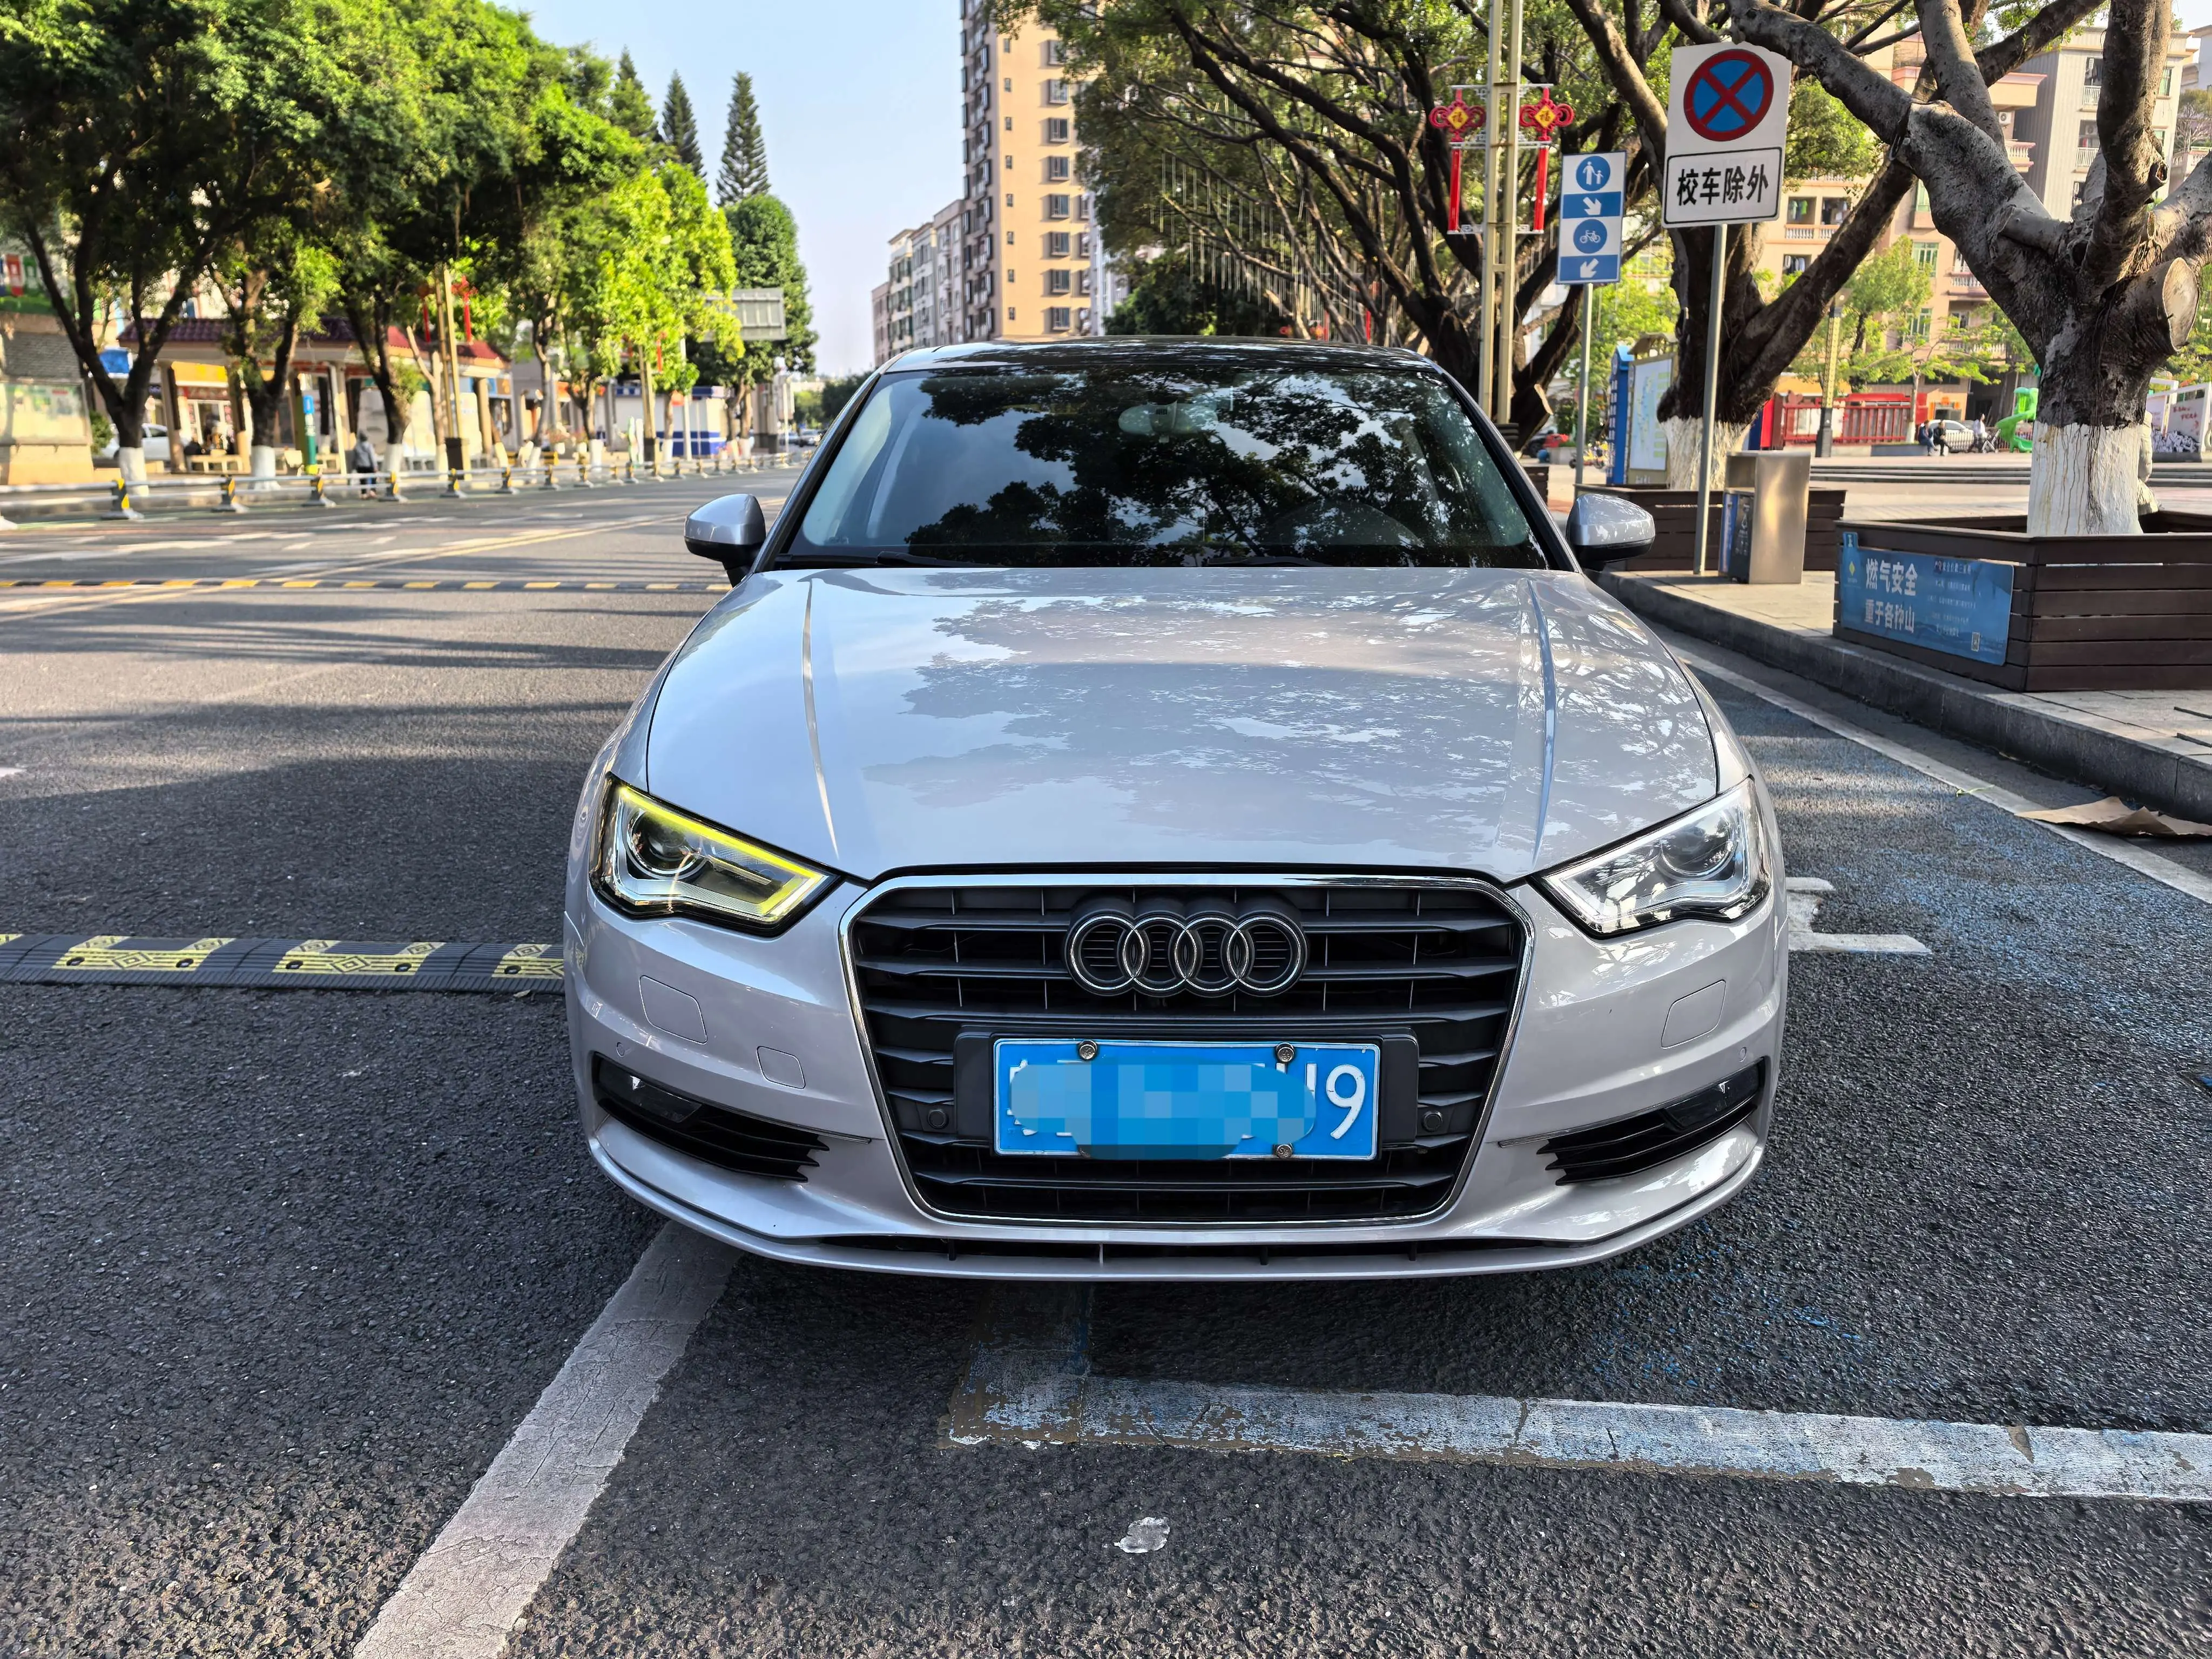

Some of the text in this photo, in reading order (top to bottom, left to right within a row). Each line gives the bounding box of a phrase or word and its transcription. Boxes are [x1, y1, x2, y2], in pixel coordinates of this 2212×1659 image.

[1676, 163, 1769, 206] 校车除外
[1865, 558, 1918, 596] 燃气安全
